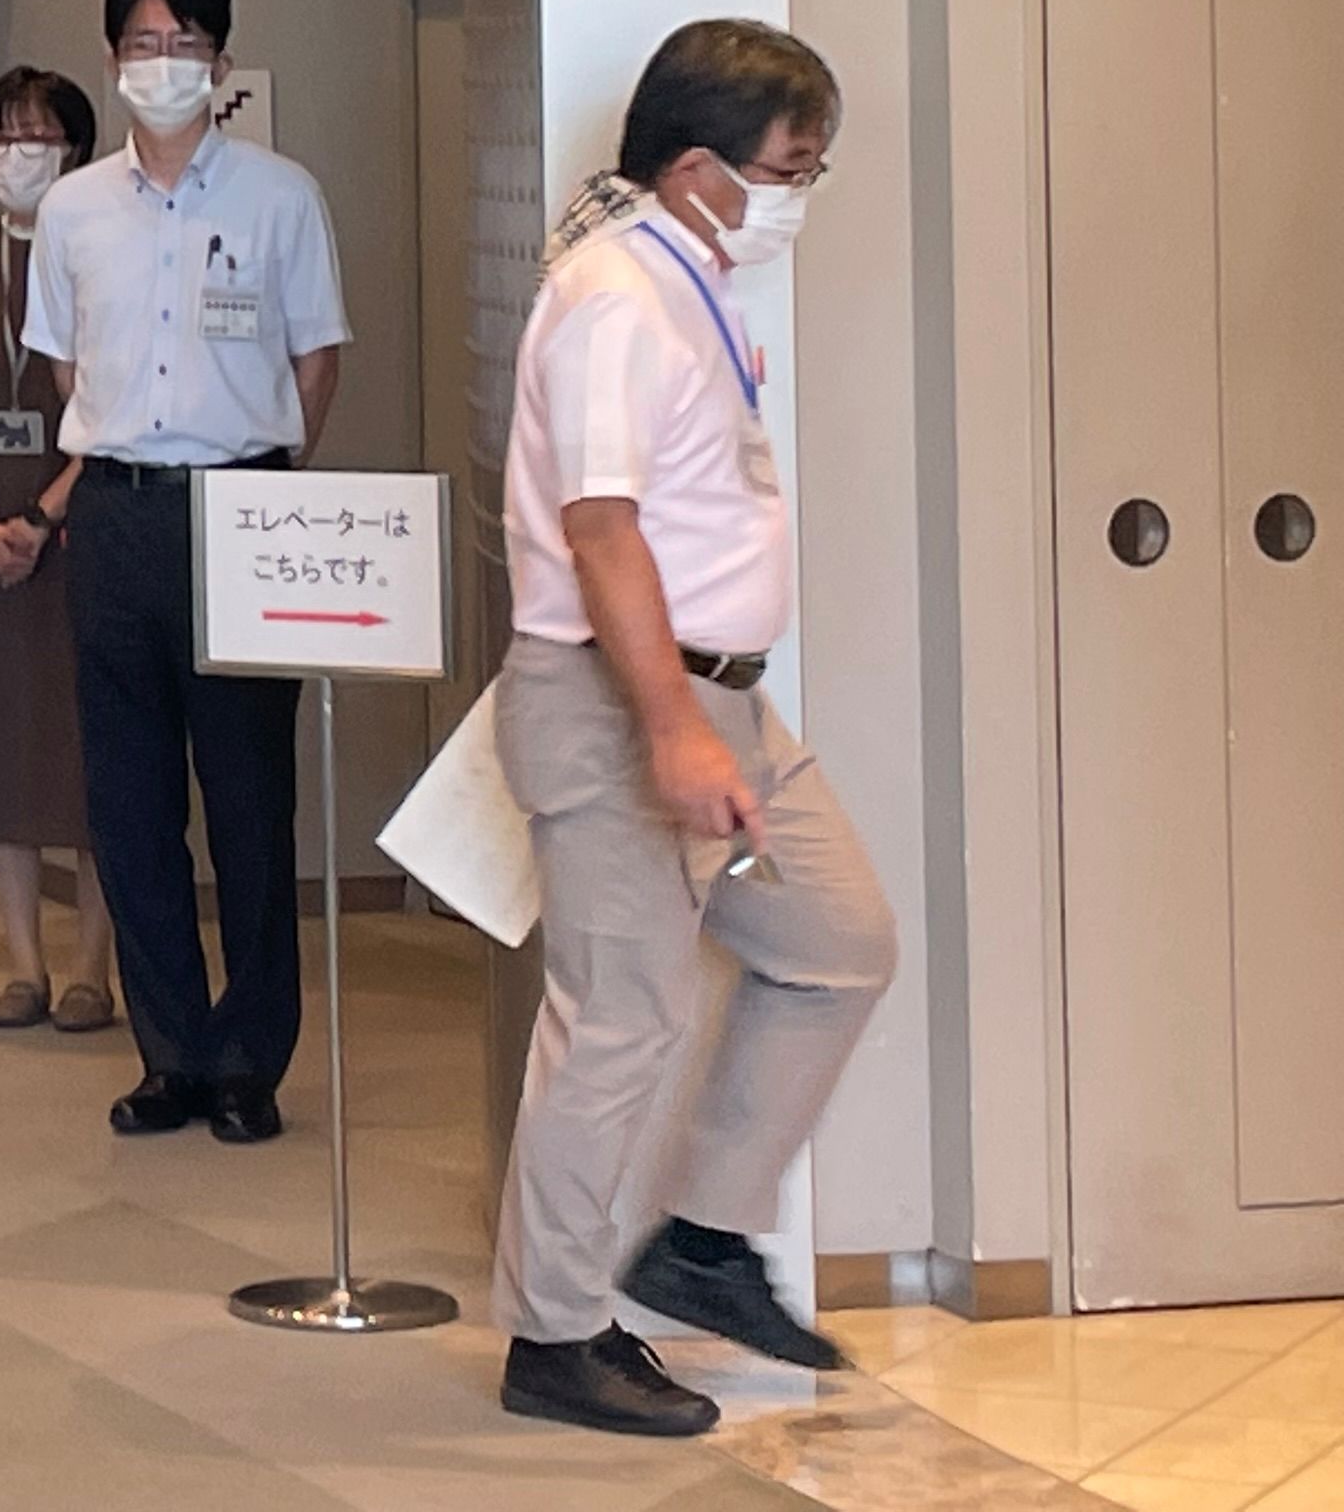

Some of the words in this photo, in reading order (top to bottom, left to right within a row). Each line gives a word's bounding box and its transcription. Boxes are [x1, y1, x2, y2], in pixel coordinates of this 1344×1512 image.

[235, 506, 411, 538] エレベーターは
[254, 553, 389, 588] こちらです。
